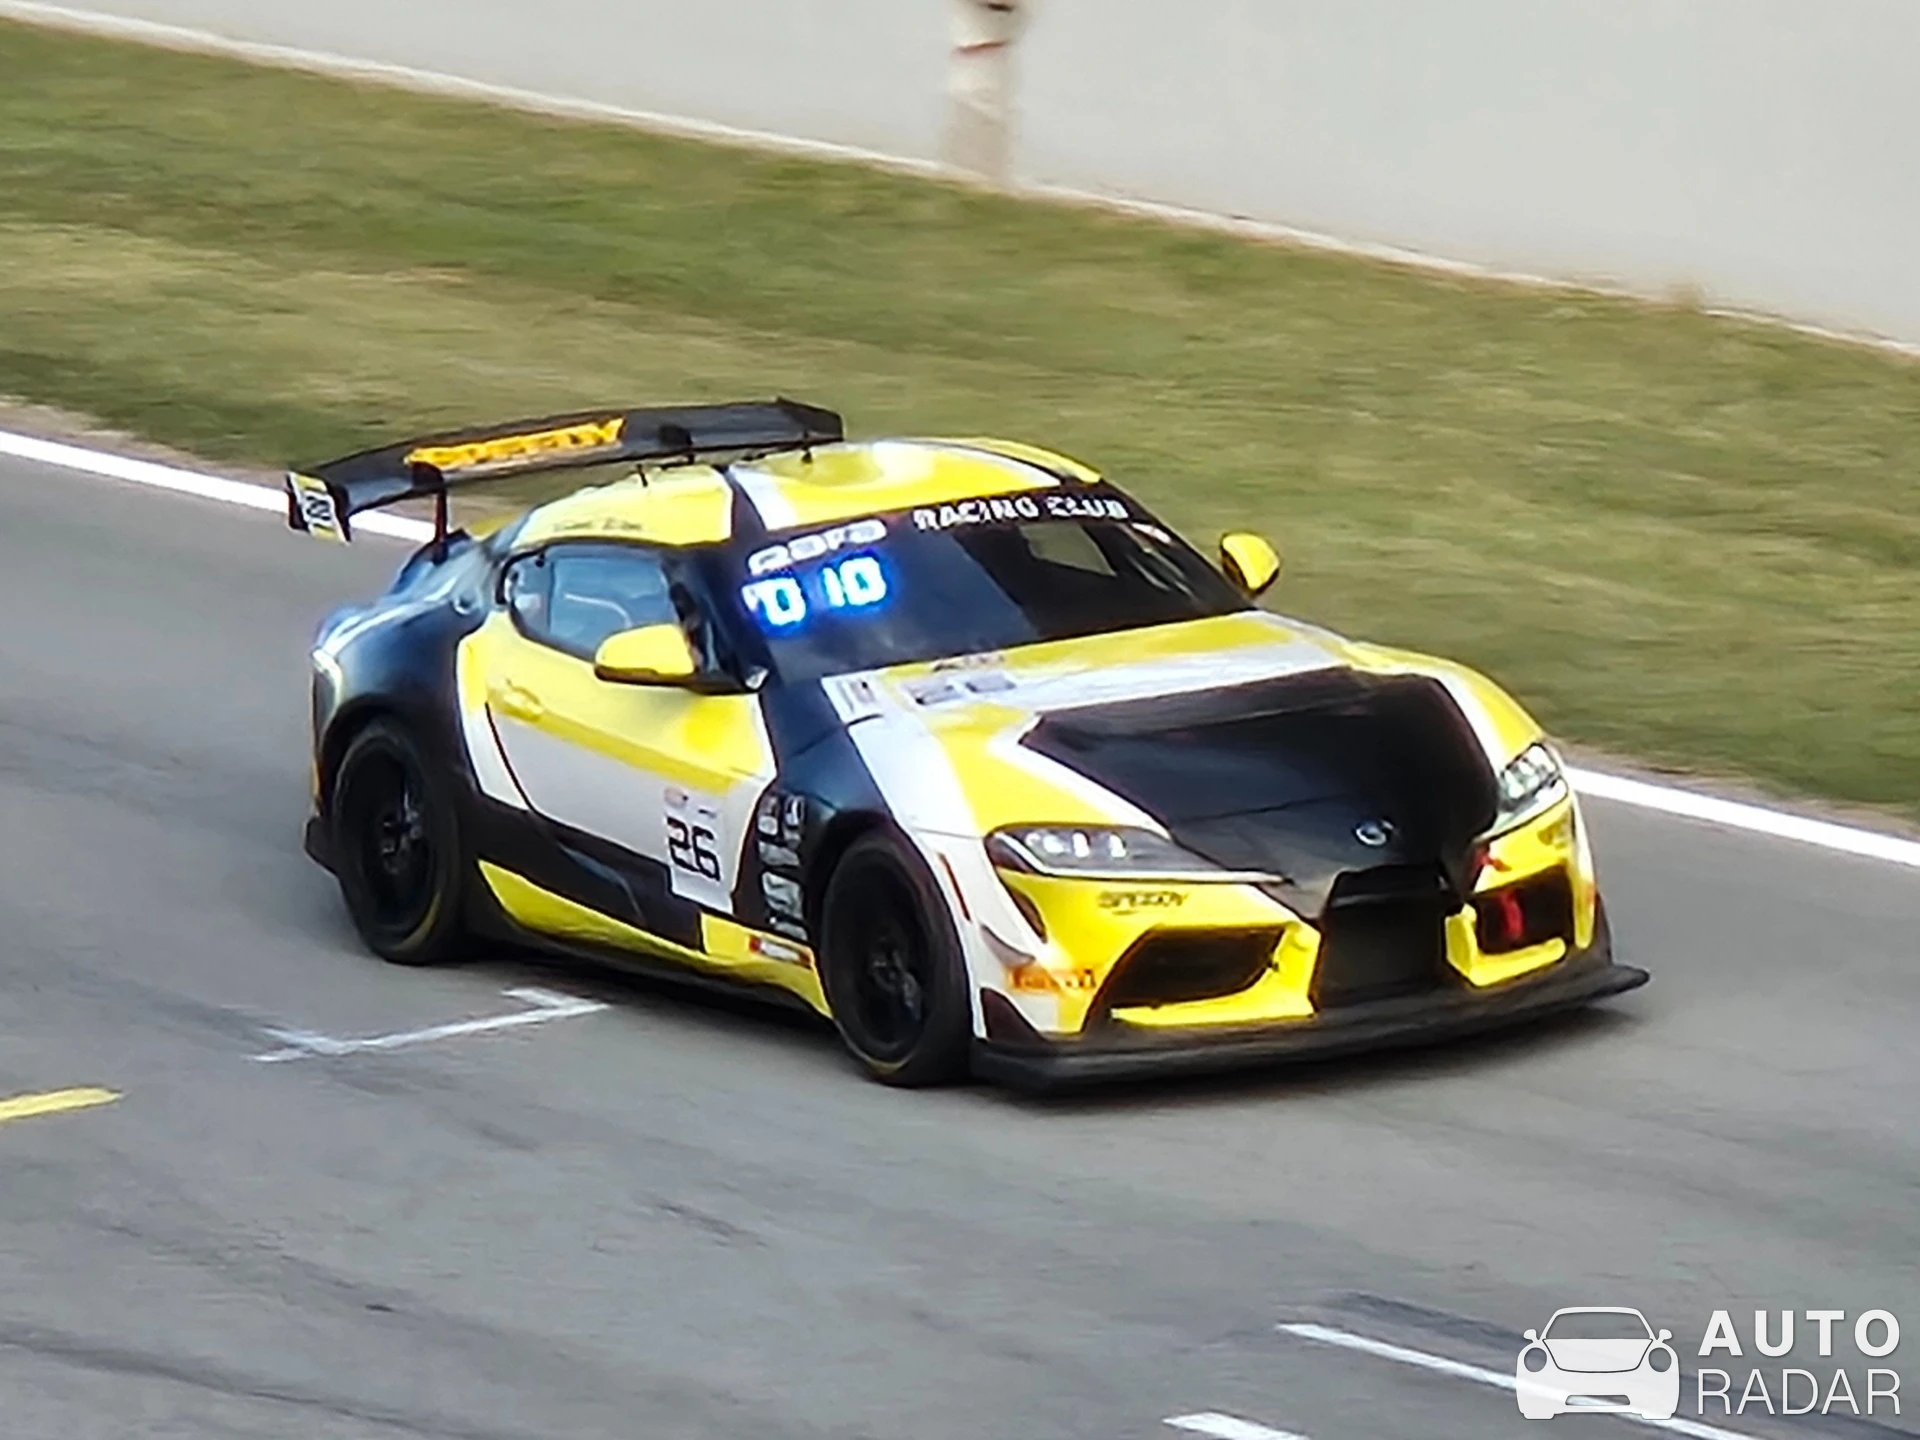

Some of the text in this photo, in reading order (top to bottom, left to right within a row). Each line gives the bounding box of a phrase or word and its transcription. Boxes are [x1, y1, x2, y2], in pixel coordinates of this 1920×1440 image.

[913, 496, 1040, 531] RACING
[1046, 496, 1129, 519] CLUB
[666, 816, 721, 882] 26
